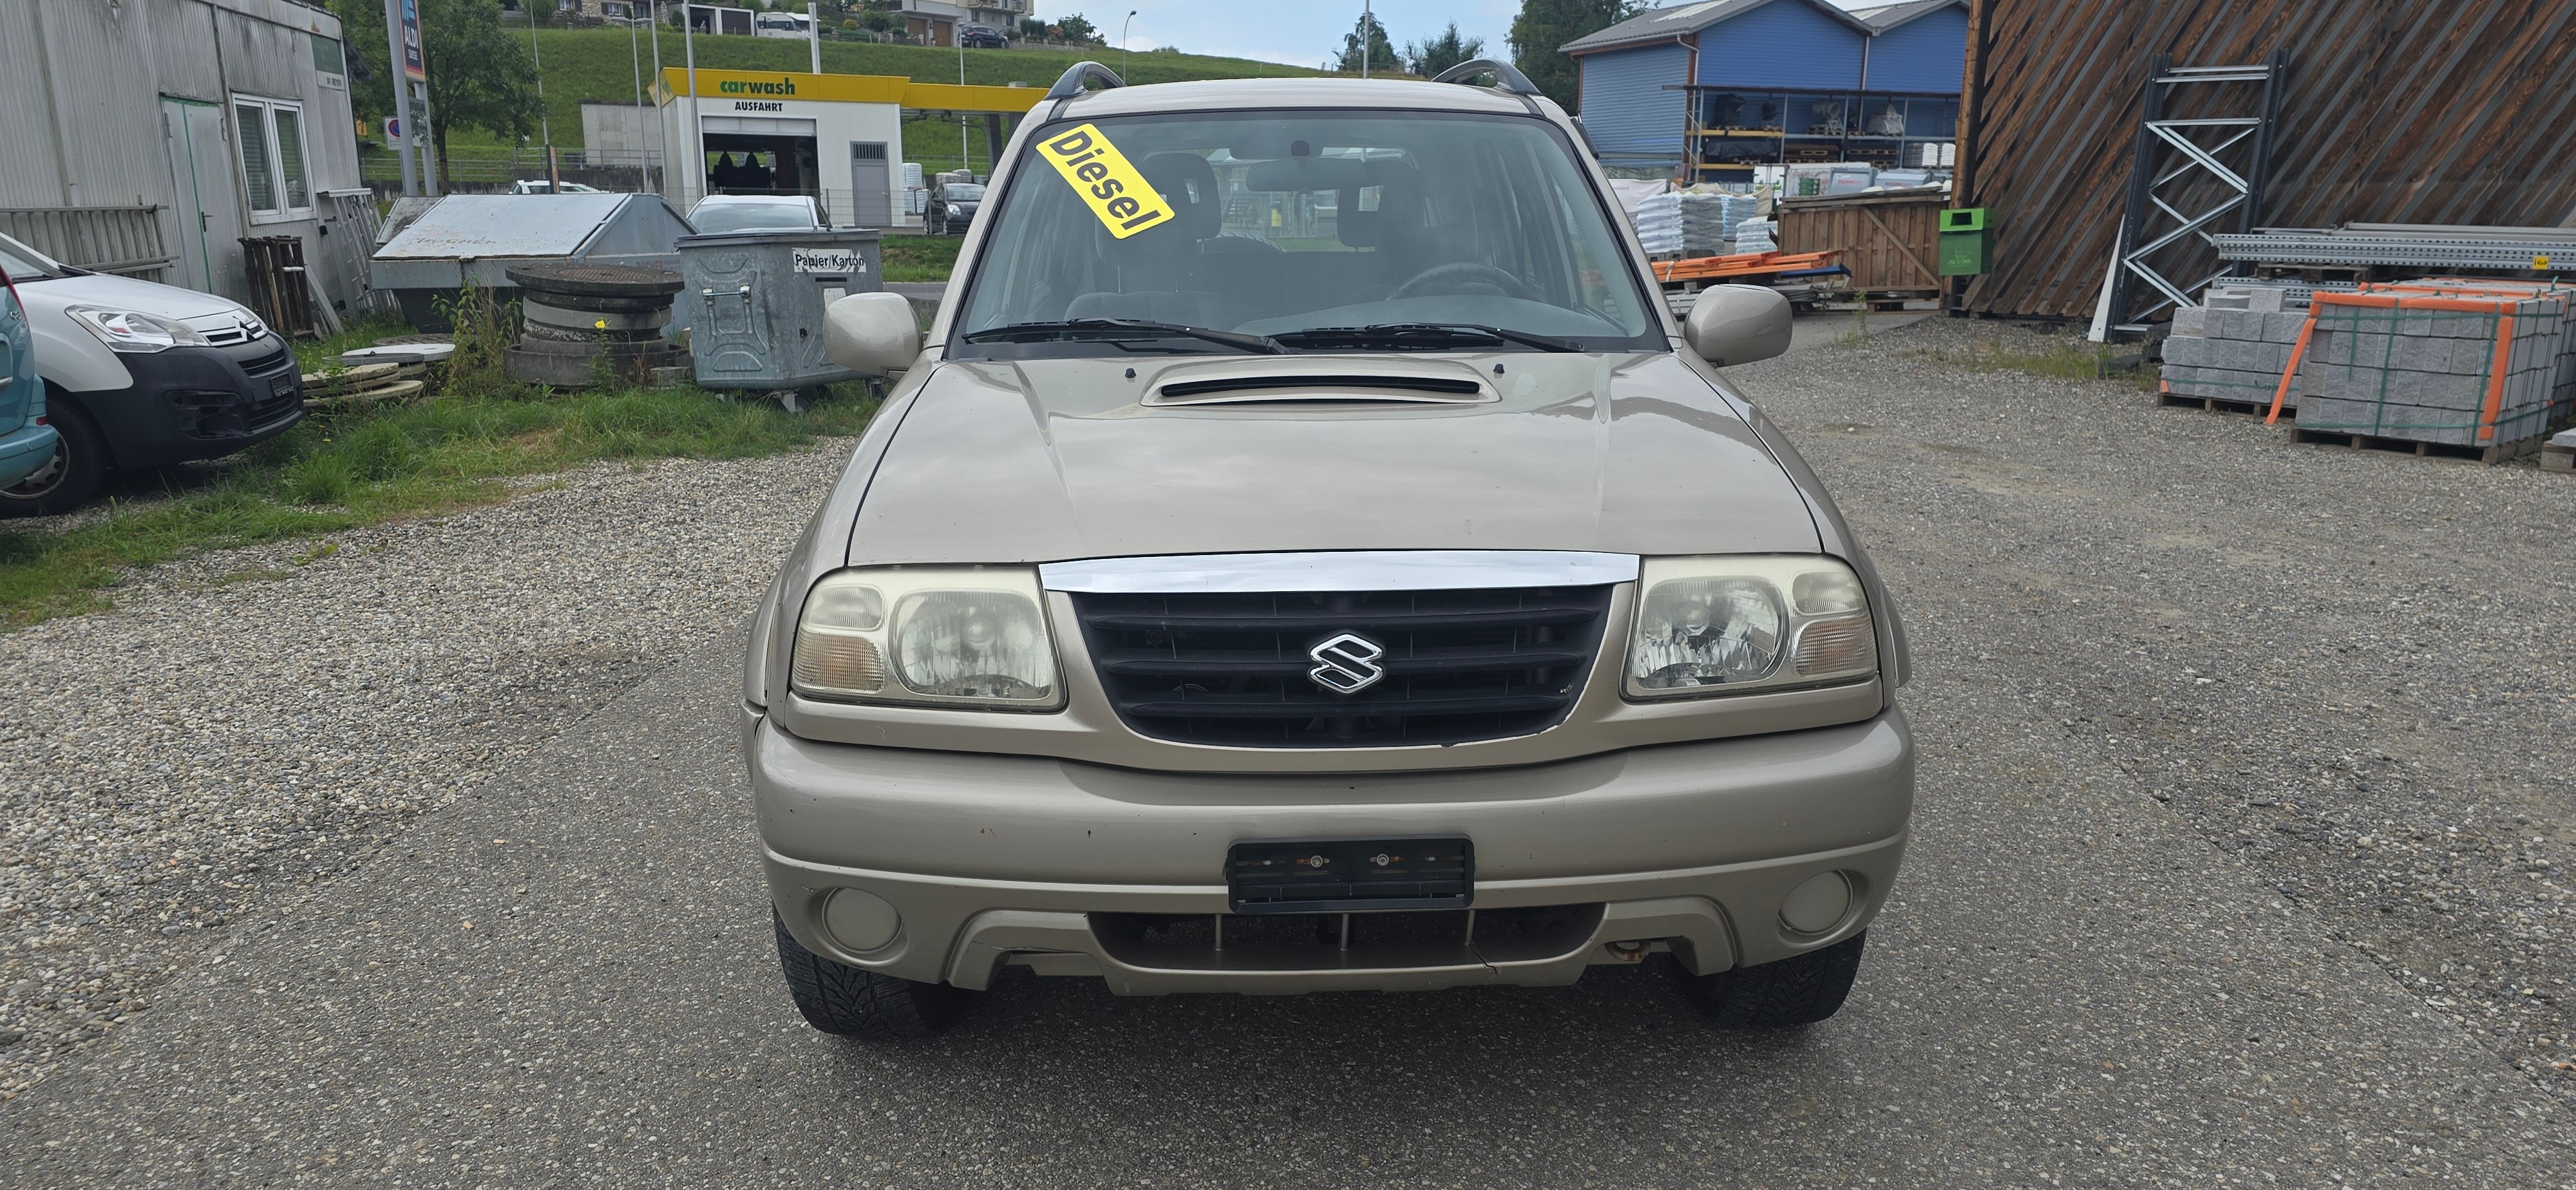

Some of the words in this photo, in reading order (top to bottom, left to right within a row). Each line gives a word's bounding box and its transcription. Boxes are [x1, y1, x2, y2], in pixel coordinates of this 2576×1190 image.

[404, 25, 419, 49] ALDI
[720, 77, 795, 95] carwash
[735, 102, 783, 111] AUSFAHRT
[1049, 130, 1162, 231] Diesel
[795, 254, 864, 269] Papier/Karton
